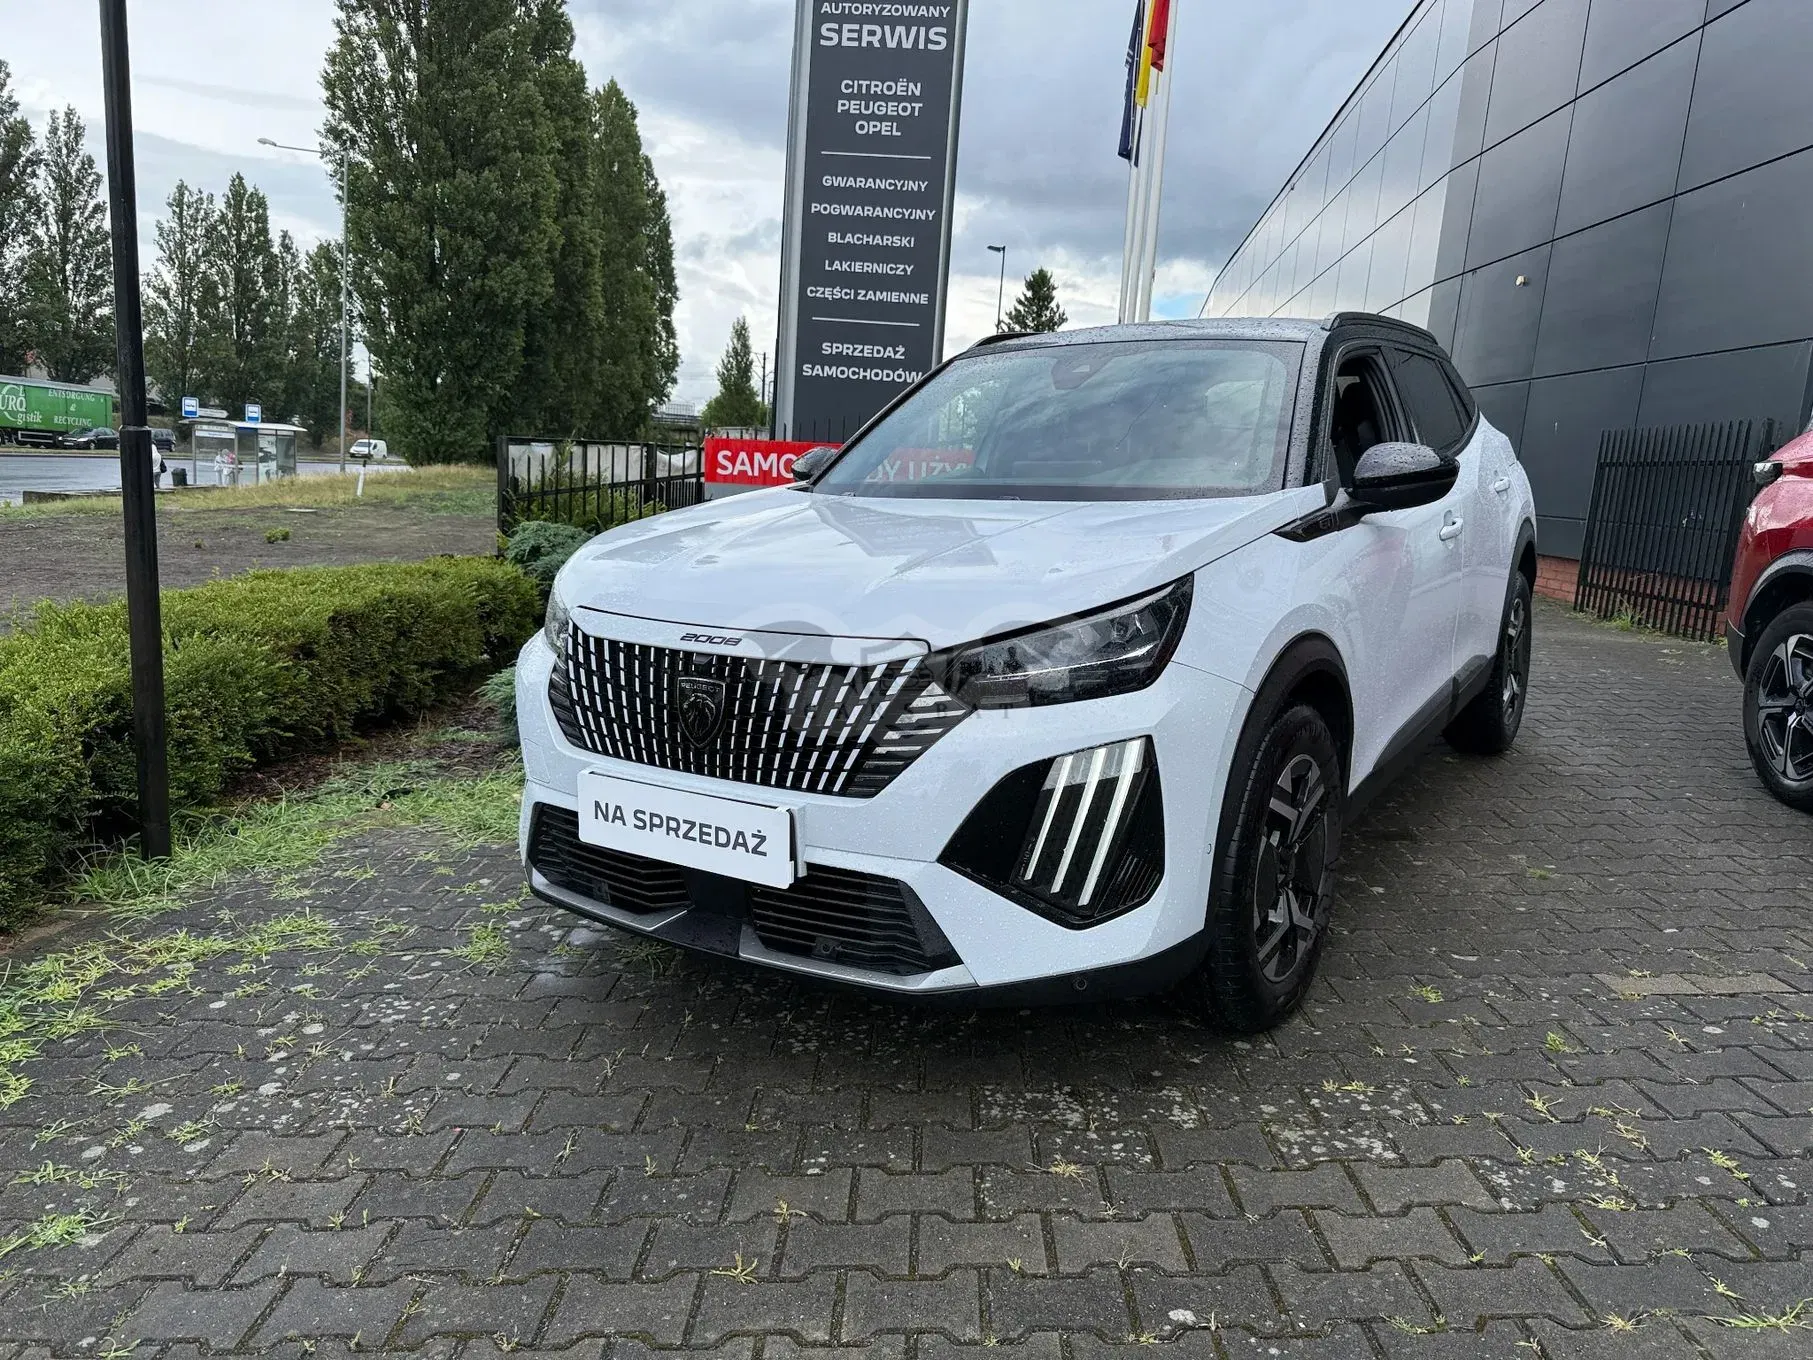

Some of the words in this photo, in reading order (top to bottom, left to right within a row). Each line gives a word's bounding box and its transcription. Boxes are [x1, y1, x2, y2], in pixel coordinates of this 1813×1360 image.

[821, 2, 951, 18] AUTORYZOWANY
[819, 22, 948, 51] SERWIS
[840, 78, 921, 97] CITROËN
[837, 99, 923, 117] PEUGEOT
[855, 120, 902, 136] OPEL
[822, 175, 929, 192] GWARANCYJNY
[810, 202, 936, 221] POGWARANCYJNY
[827, 231, 915, 248] BLACHARSKI
[824, 259, 914, 275] LAKIERNICZY
[806, 285, 854, 301] CZĘŚCI
[857, 289, 929, 305] ZAMIENNE
[821, 341, 906, 360] SPRZEDAŻ
[802, 363, 923, 383] SAMOCHODÓW
[53, 415, 92, 426] RECYCLING
[680, 632, 743, 647] 2008
[680, 682, 721, 693] PEUGEOT
[594, 800, 627, 827] NA
[633, 808, 768, 858] SPRZEDAŻ
